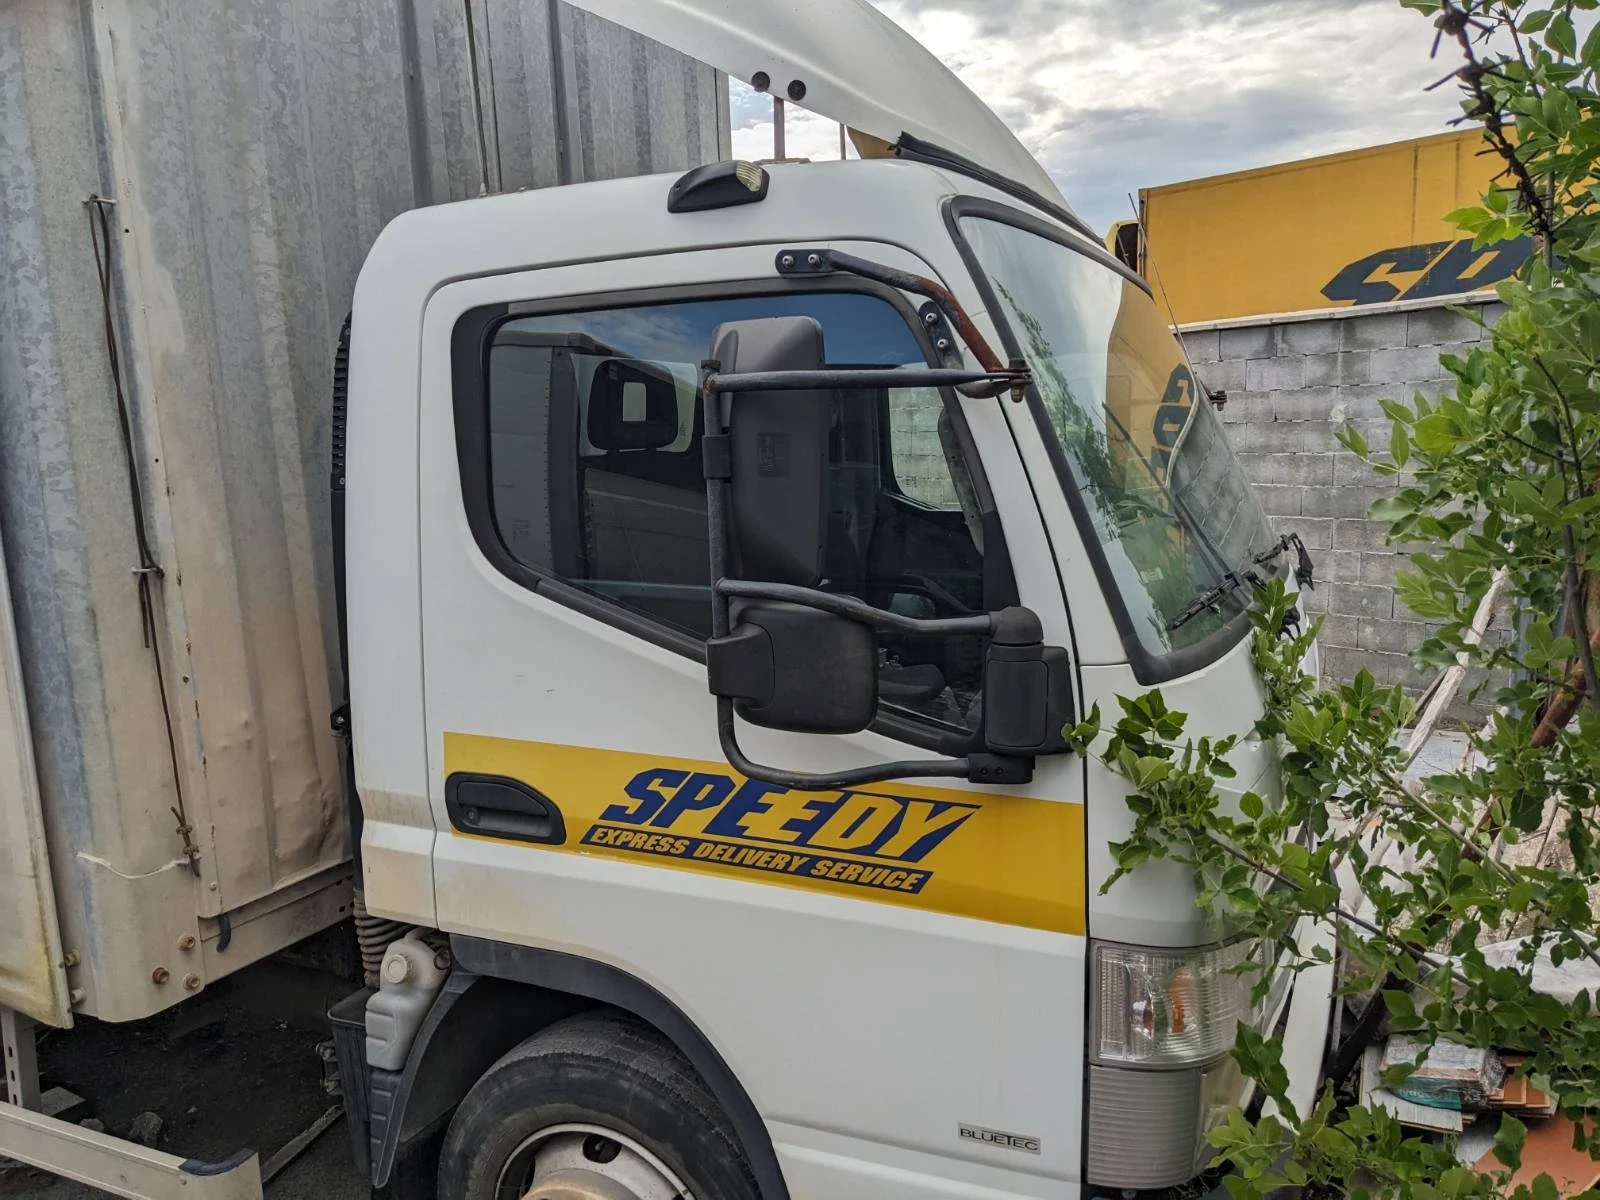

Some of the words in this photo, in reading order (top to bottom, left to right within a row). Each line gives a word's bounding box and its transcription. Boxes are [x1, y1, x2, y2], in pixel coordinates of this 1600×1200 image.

[599, 768, 982, 863] SPEEDY
[590, 828, 690, 855] EXPRESS
[692, 842, 811, 872] DELIVERY
[810, 860, 924, 890] SERVICE
